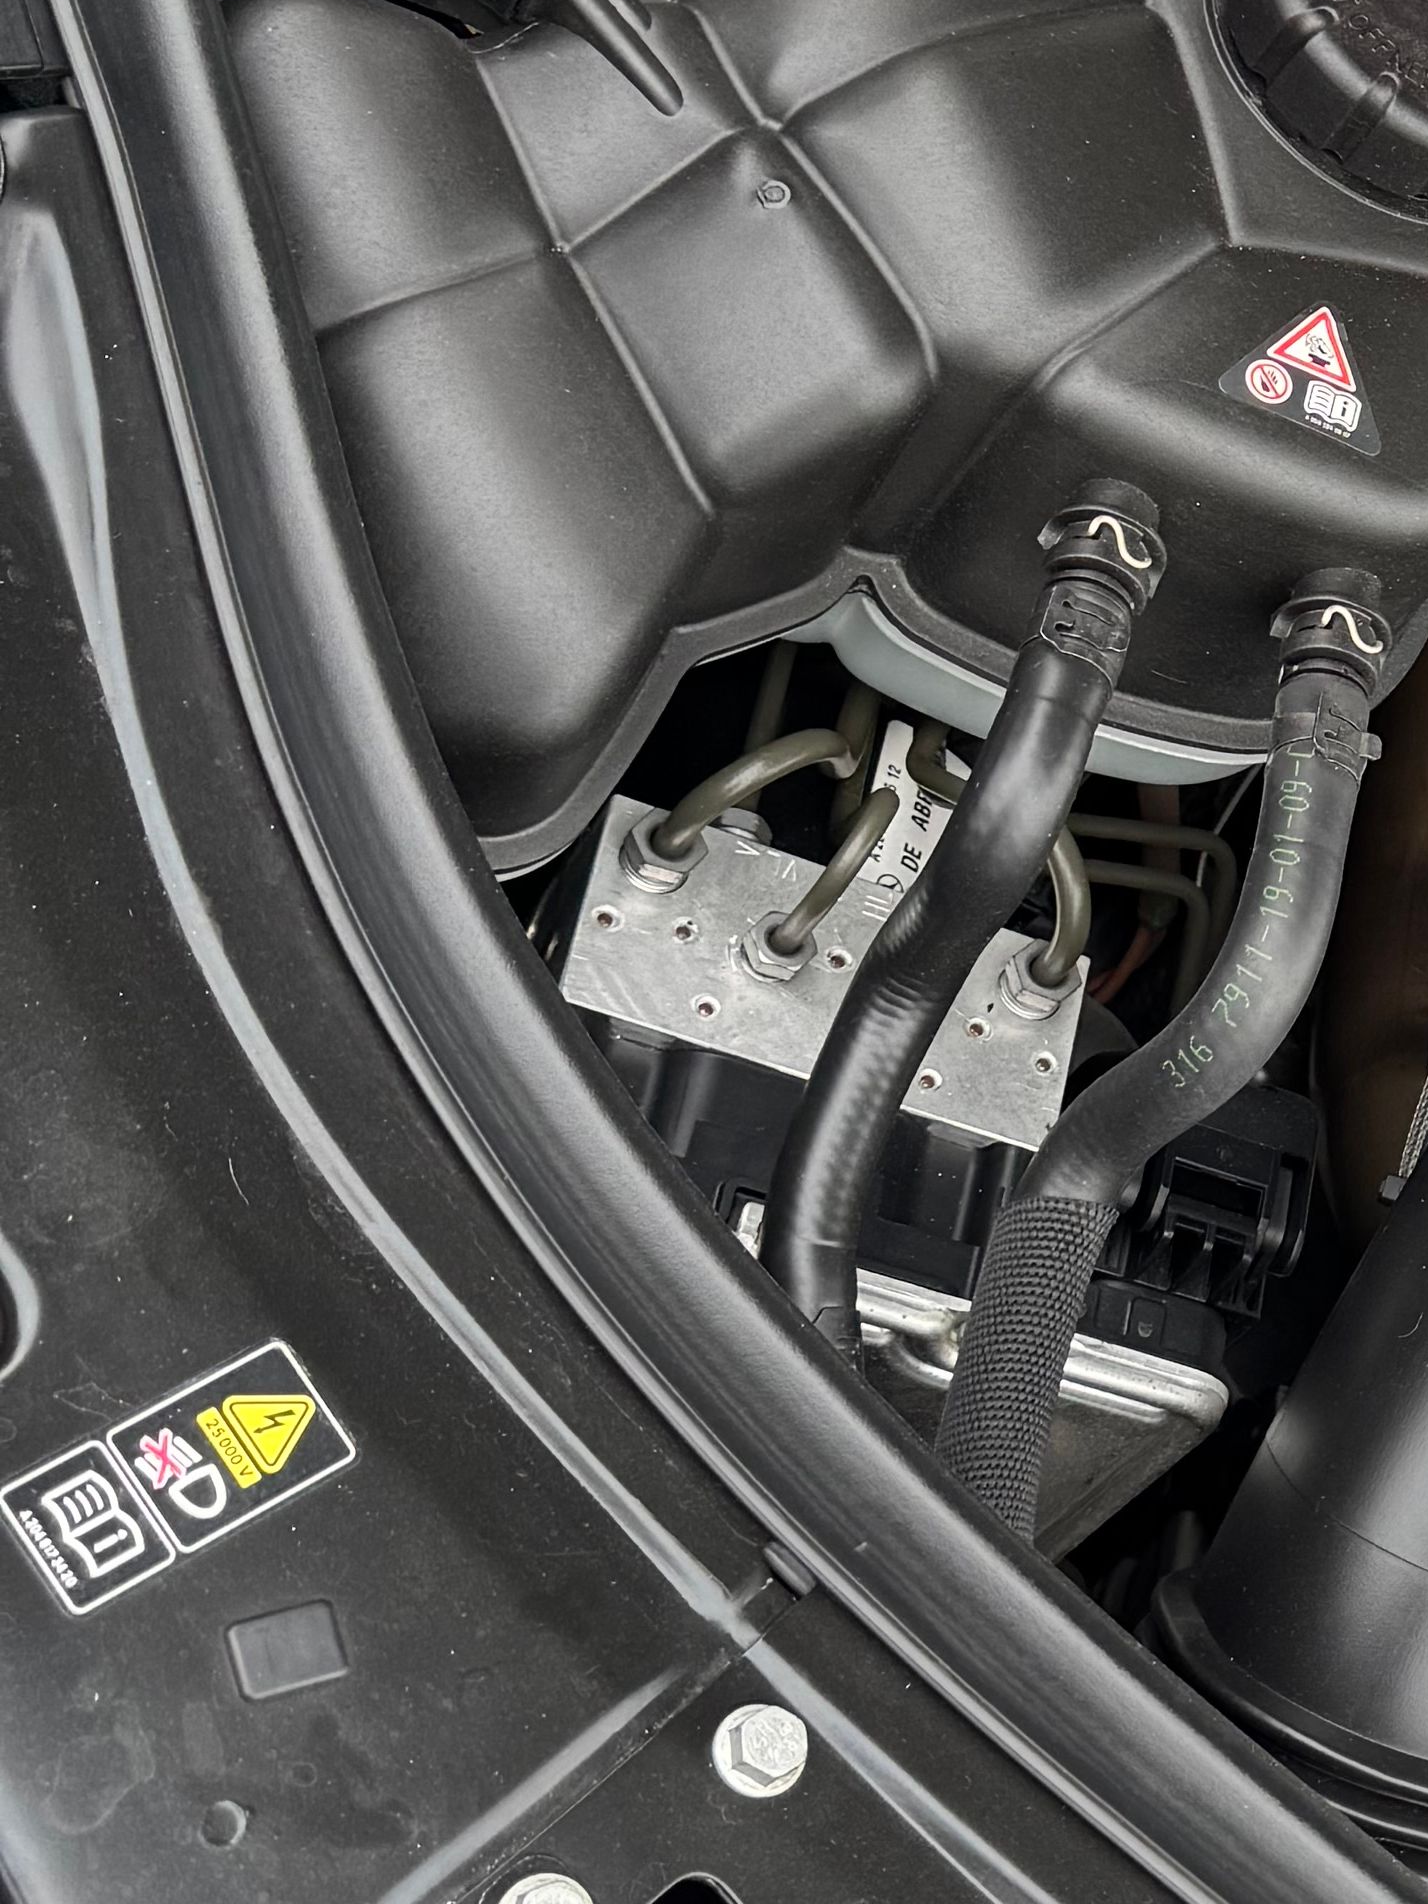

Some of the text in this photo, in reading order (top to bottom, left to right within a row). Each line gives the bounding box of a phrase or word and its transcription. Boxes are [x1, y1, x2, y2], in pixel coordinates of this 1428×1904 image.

[901, 842, 922, 873] DE
[1162, 1035, 1213, 1089] 316
[239, 1466, 254, 1479] V
